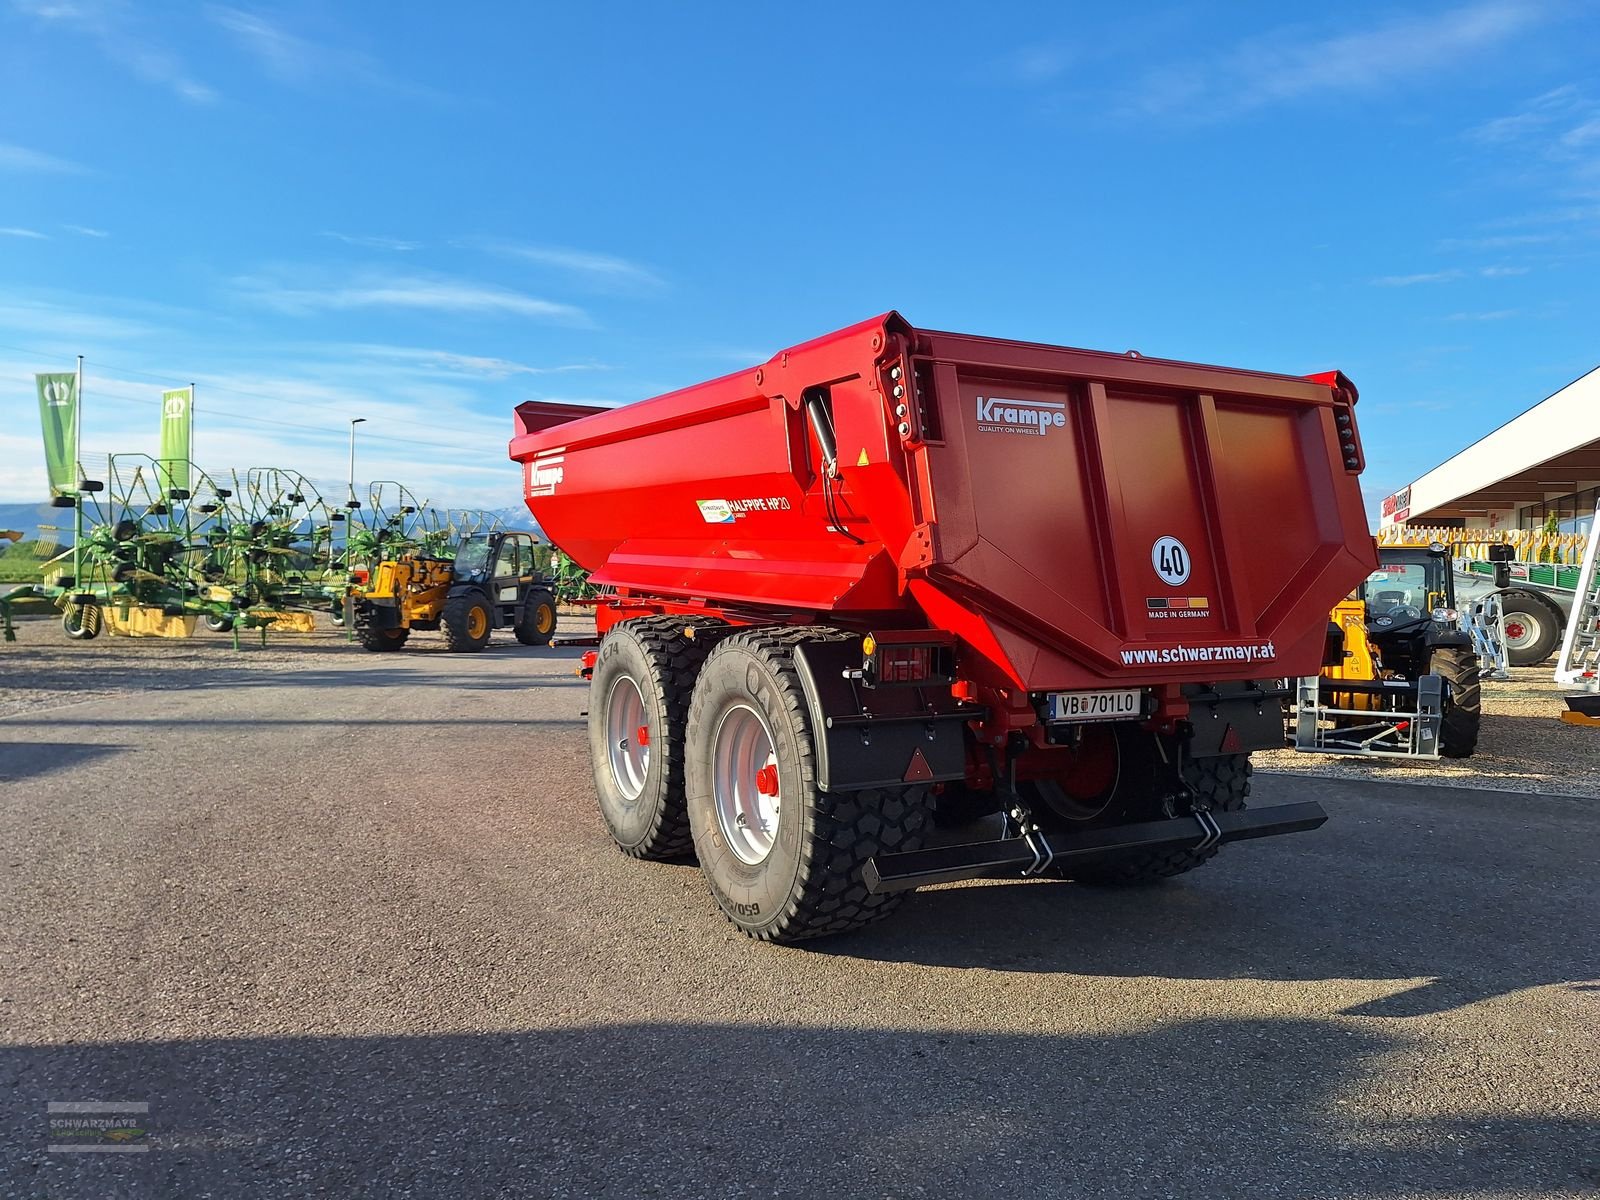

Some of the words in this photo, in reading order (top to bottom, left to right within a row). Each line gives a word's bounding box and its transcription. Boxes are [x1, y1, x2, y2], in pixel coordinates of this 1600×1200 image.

[976, 396, 1066, 435] Krampe
[978, 425, 1004, 433] QUALITY
[1016, 427, 1039, 435] WHEELS
[726, 499, 768, 512] HALFPIPE
[766, 497, 790, 510] HP20
[1159, 545, 1185, 577] 40
[1148, 611, 1169, 619] MADE
[1178, 610, 1210, 618] GERMANY
[1120, 640, 1276, 665] www.schwarzmayr.at
[1061, 696, 1079, 715] VB
